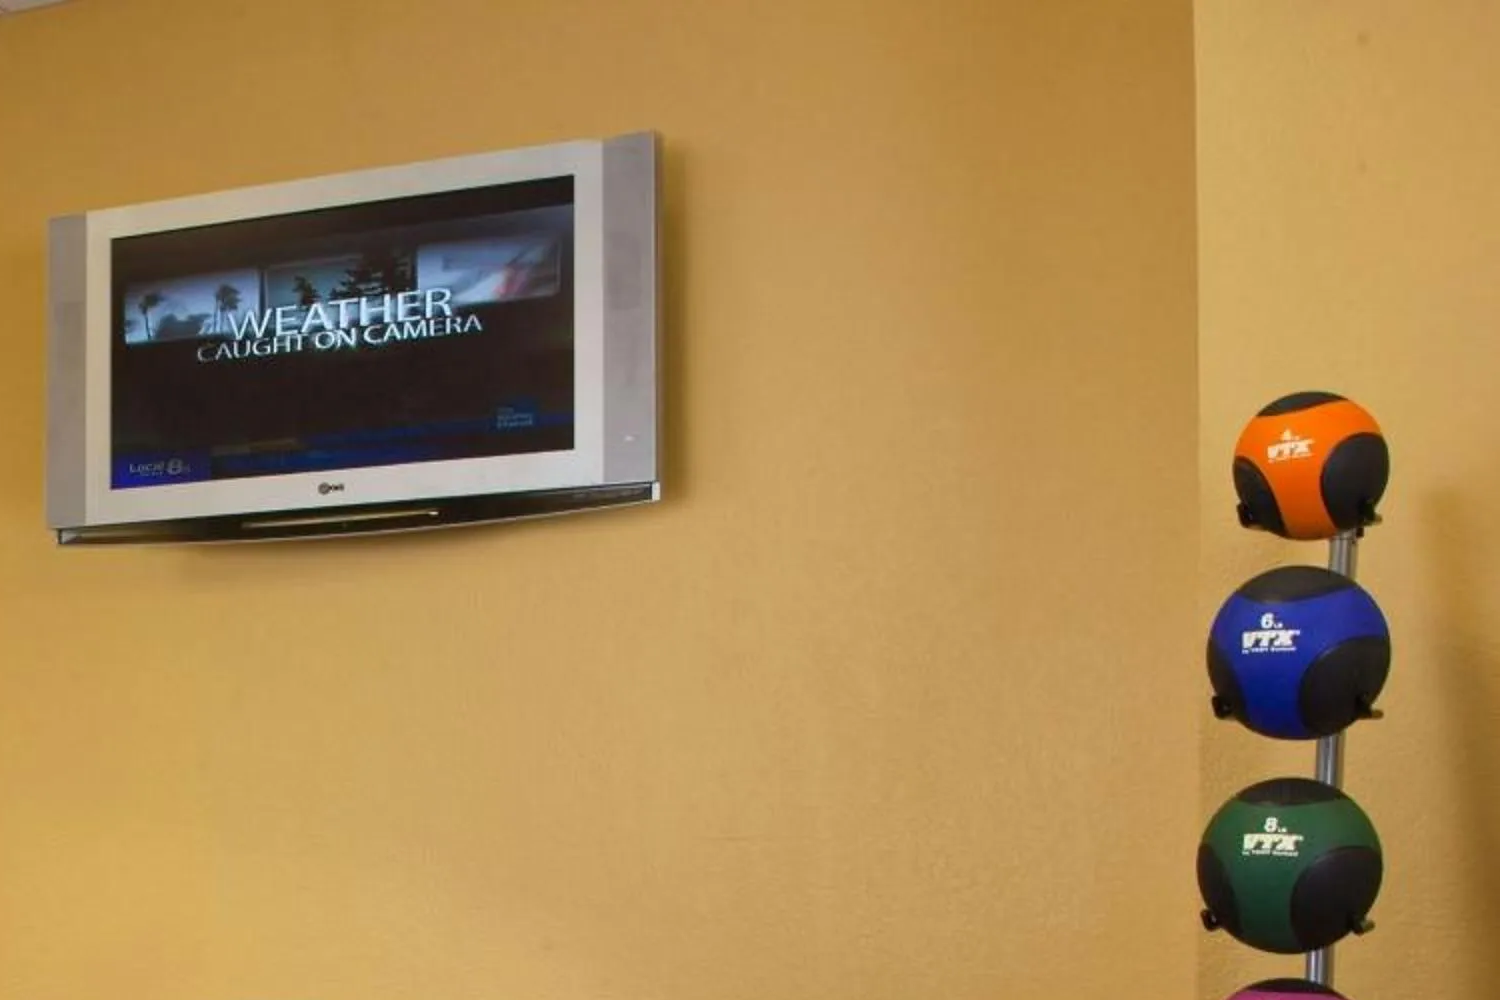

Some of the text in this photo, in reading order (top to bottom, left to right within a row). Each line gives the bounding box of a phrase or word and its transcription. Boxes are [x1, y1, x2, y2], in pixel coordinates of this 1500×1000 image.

[227, 287, 453, 341] WEATHER
[197, 313, 484, 362] CAUGHT ON CAMERA
[1260, 612, 1274, 629] 6
[1242, 630, 1300, 649] VTX
[1264, 816, 1278, 833] 8
[1243, 833, 1303, 850] VTX
